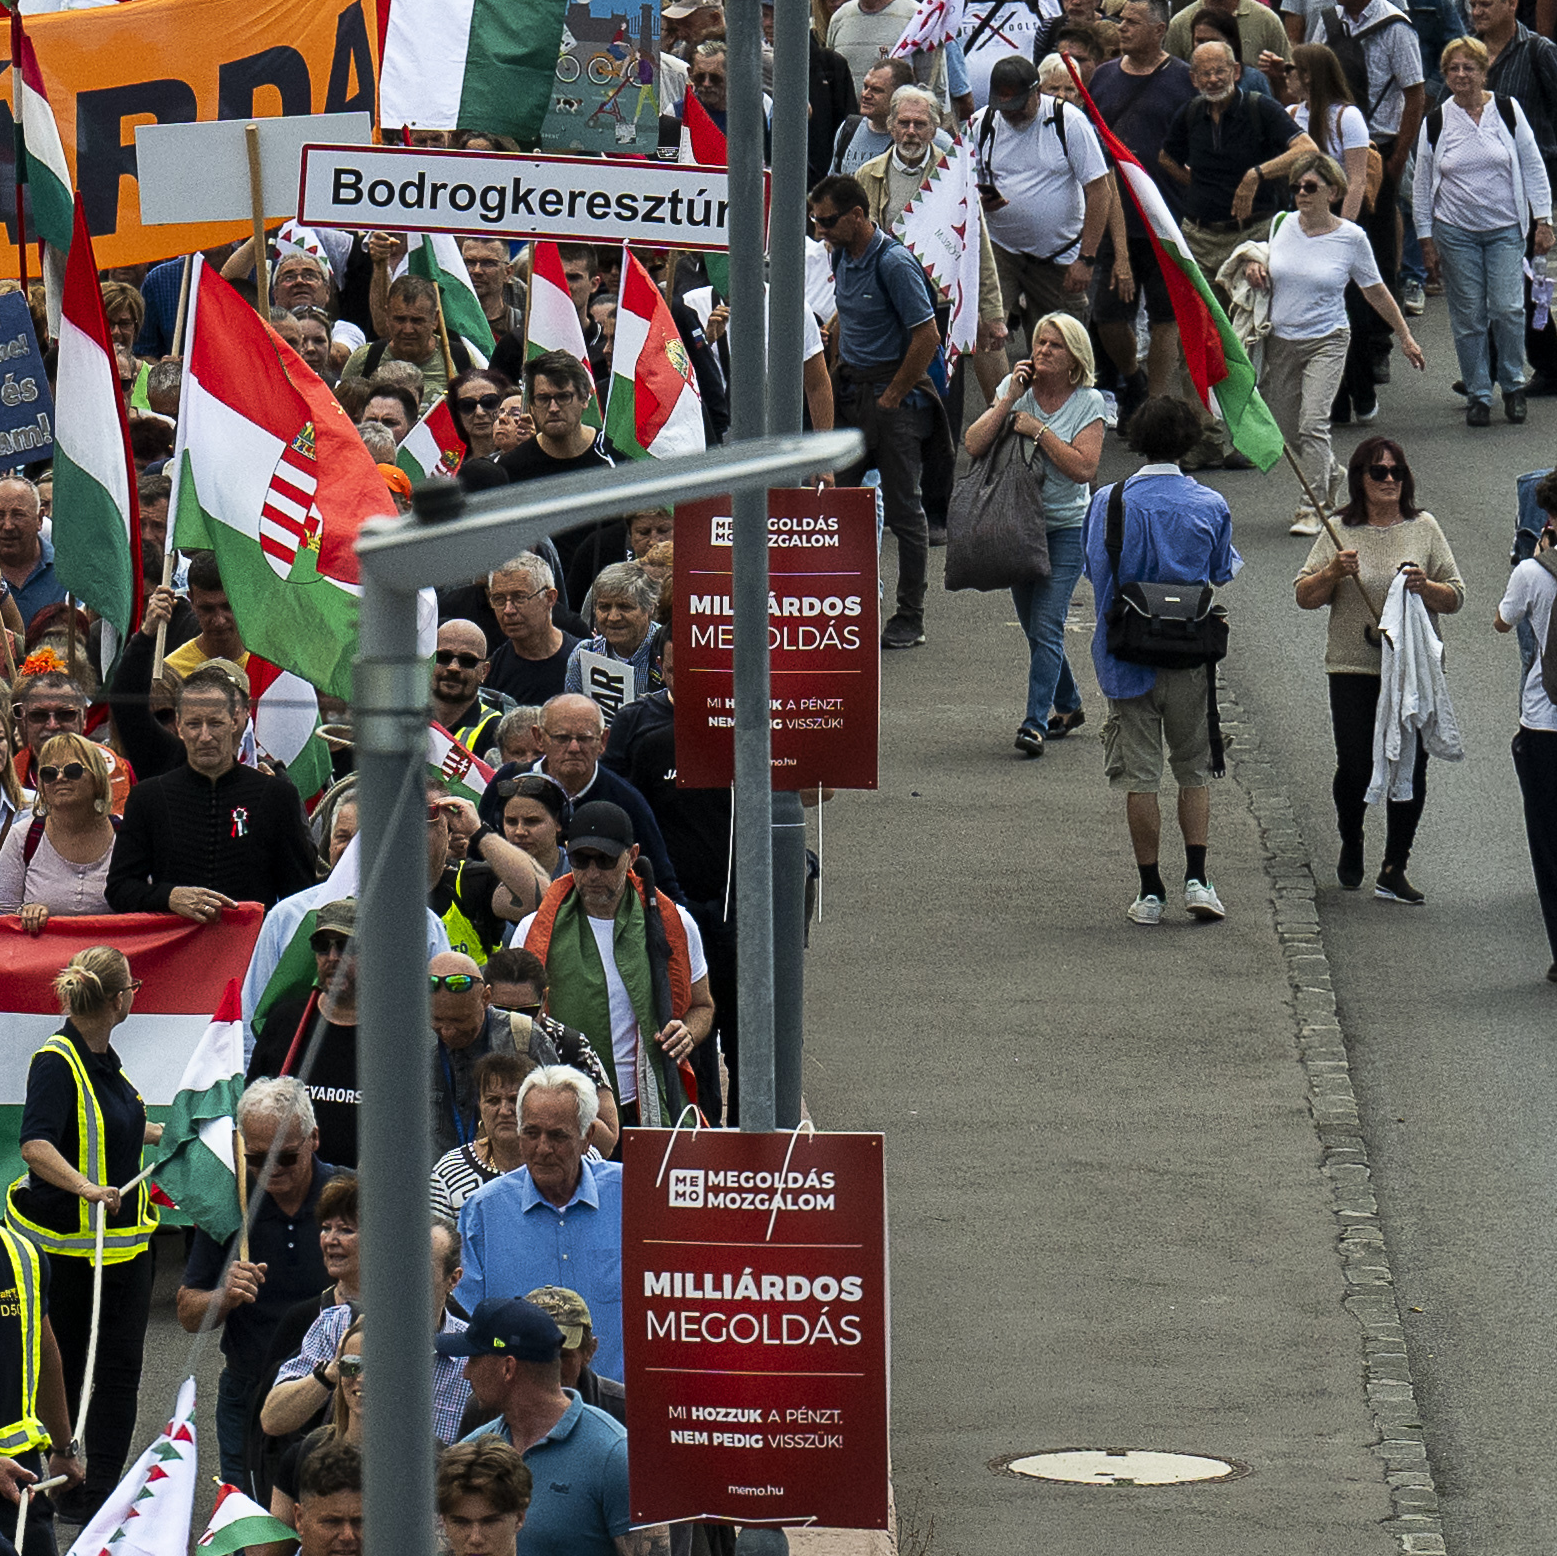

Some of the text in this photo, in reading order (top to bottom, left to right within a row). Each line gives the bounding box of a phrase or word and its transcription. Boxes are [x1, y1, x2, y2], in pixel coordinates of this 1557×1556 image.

[331, 166, 729, 229] Bodrogkeresztúr
[0, 372, 39, 407] és
[767, 515, 839, 531] GOLDÁS
[767, 533, 839, 547] ZGALOM
[689, 591, 862, 616] MILÁRDOS
[691, 619, 861, 650] MEOLDÁS
[707, 697, 721, 708] MI
[786, 699, 796, 711] A
[786, 714, 844, 730] VISSZÜK!
[674, 1175, 700, 1186] ME
[707, 1167, 836, 1189] MEGOLDÁS
[674, 1189, 700, 1202] MO
[707, 1192, 836, 1211] MOZGALOM
[644, 1267, 863, 1302] MILLIÁRDOS
[646, 1306, 862, 1345] MEGOLDÁS
[668, 1405, 843, 1424] MI HOZZUK A PÉNZT.
[670, 1430, 843, 1449] NEM PEDIG VISSZÜK!
[728, 1484, 784, 1497] memo.hu
